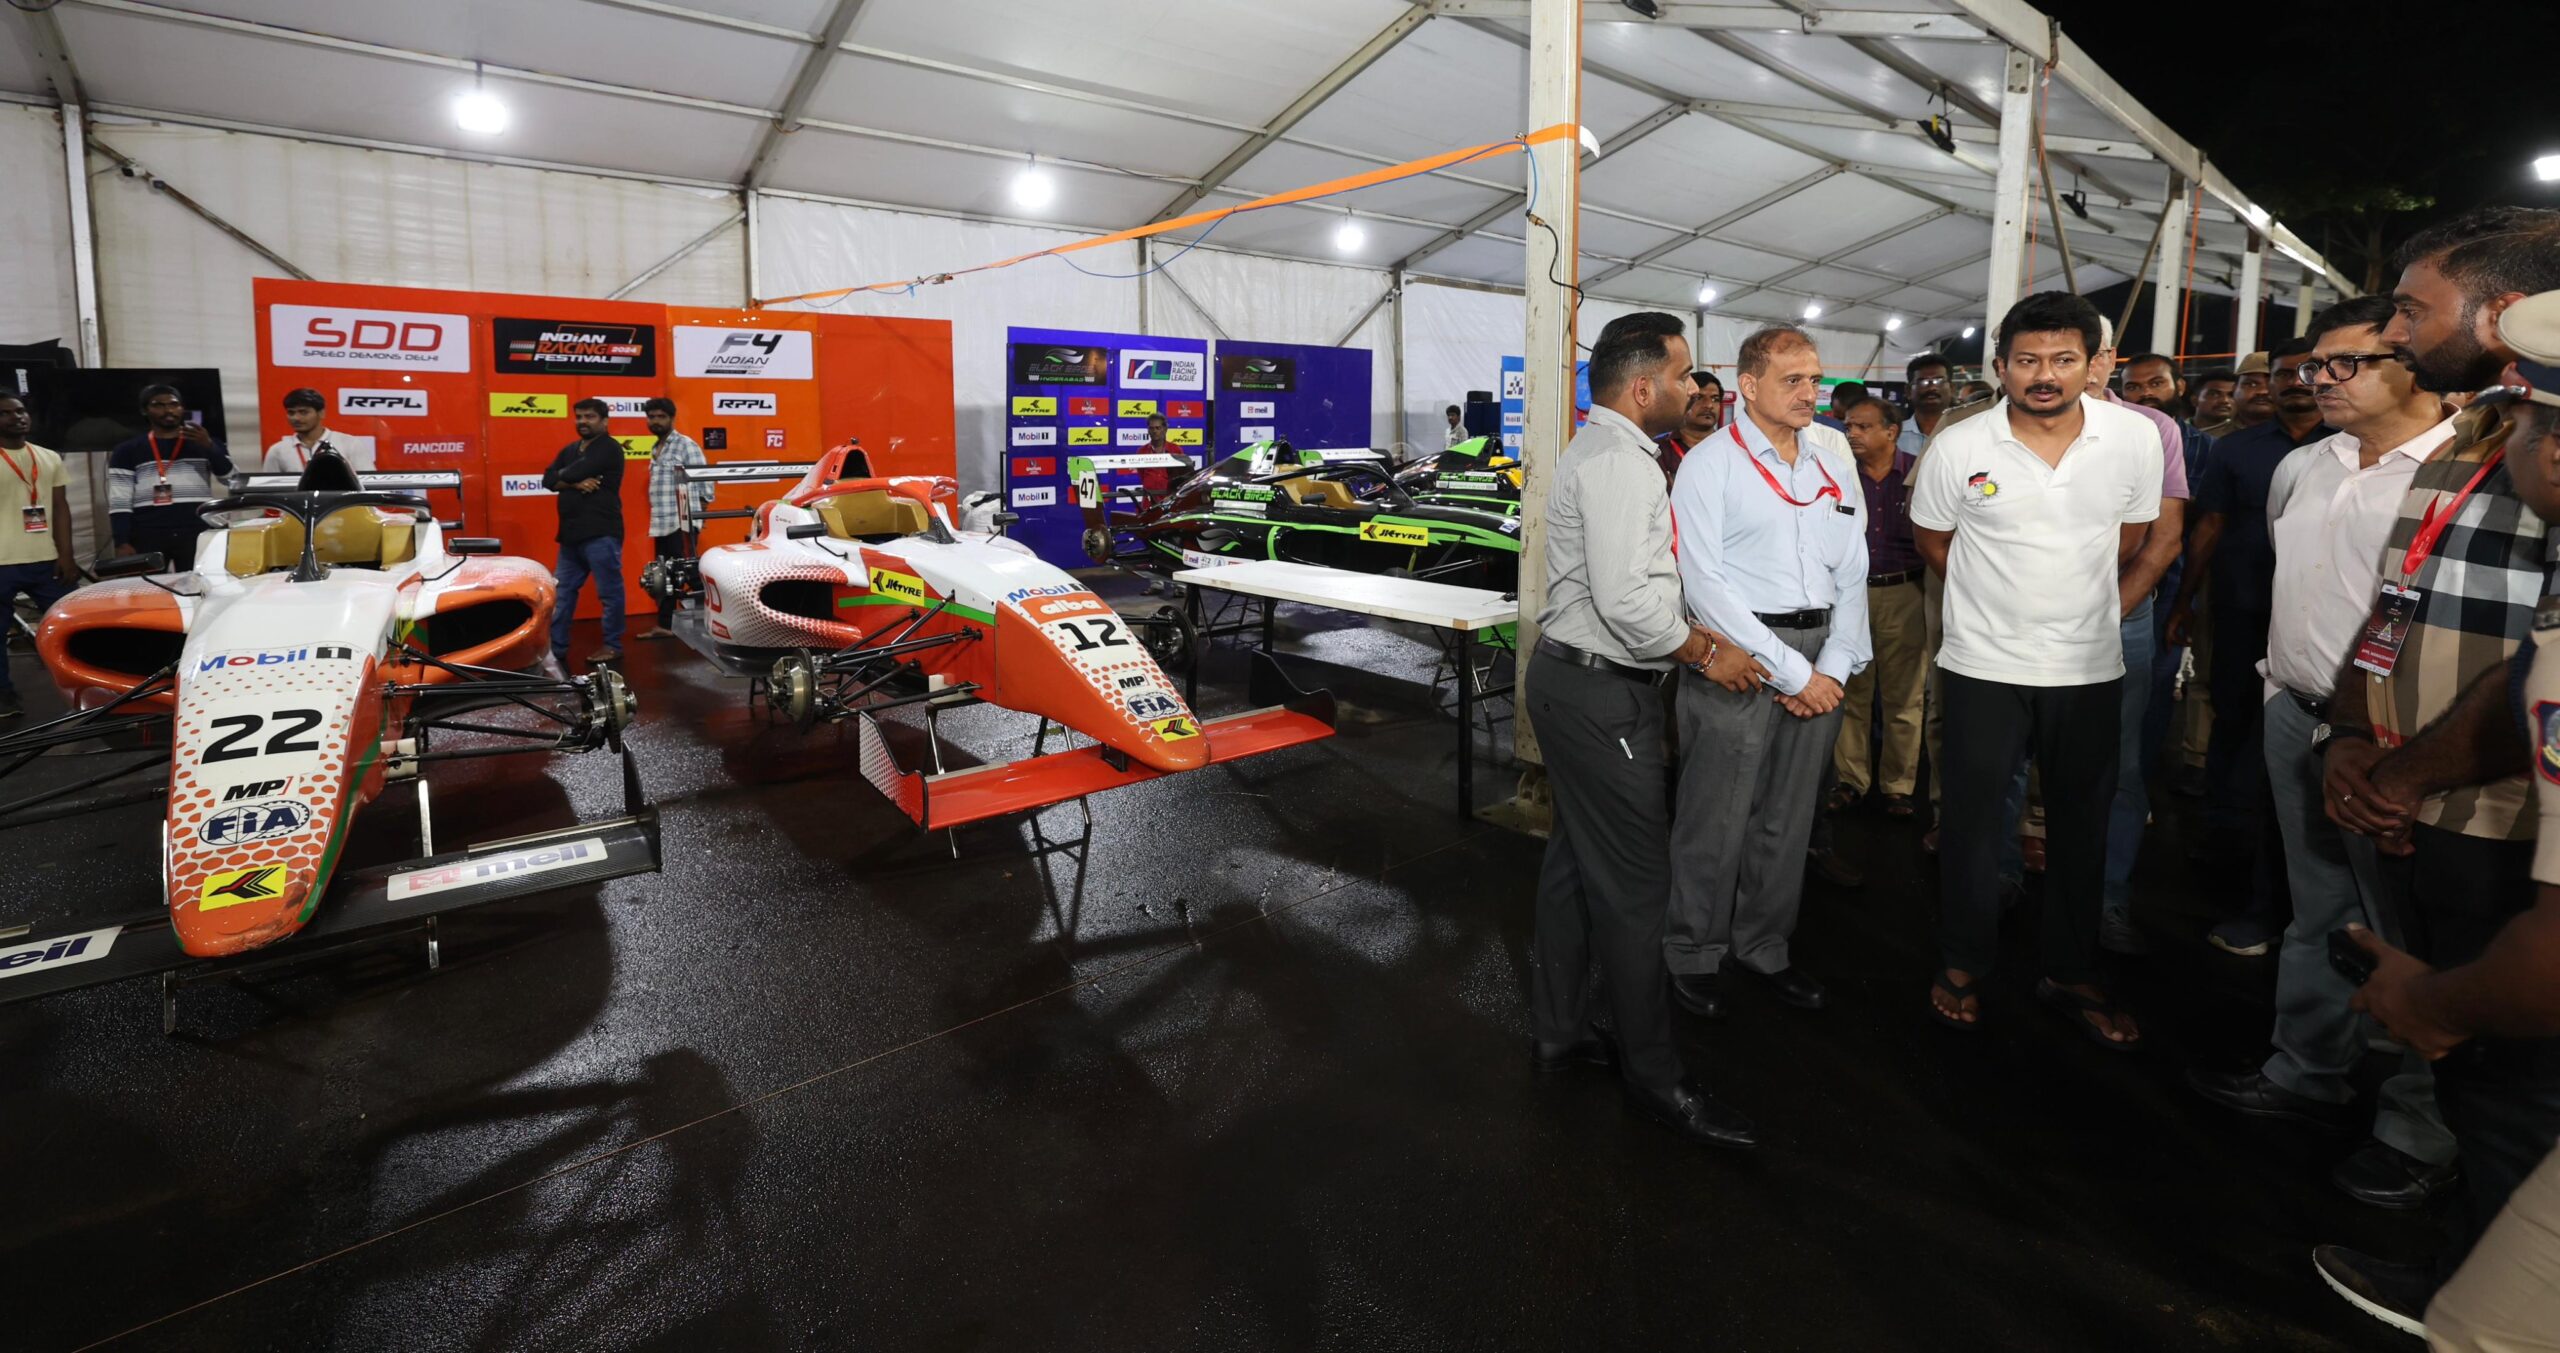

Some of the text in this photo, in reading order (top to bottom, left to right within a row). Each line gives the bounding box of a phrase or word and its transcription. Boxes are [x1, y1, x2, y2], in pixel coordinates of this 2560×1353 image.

[304, 317, 443, 352] SDD
[536, 341, 609, 355] RACING
[716, 332, 783, 355] F4
[303, 349, 439, 361] SPEED DEMONS DELHI
[533, 353, 611, 364] FESTIVAL
[710, 355, 770, 365] INDIAN
[1171, 374, 1195, 382] LEAGUE
[344, 396, 422, 408] RPPL
[608, 402, 632, 412] obil
[717, 399, 773, 409] RPPL
[767, 435, 783, 447] FC
[1018, 432, 1040, 441] Mobil
[1122, 433, 1142, 441] Mobil
[403, 442, 465, 455] FANCODE
[1080, 478, 1095, 500] 47
[1210, 487, 1242, 500] BLACK
[1018, 492, 1040, 501] Mobil
[1007, 585, 1070, 603] Mobil
[1040, 599, 1103, 615] alba
[1058, 618, 1130, 652] 12
[200, 648, 308, 672] Mobil
[200, 708, 323, 765] 22
[476, 843, 589, 878] meil
[0, 935, 93, 971] eil
